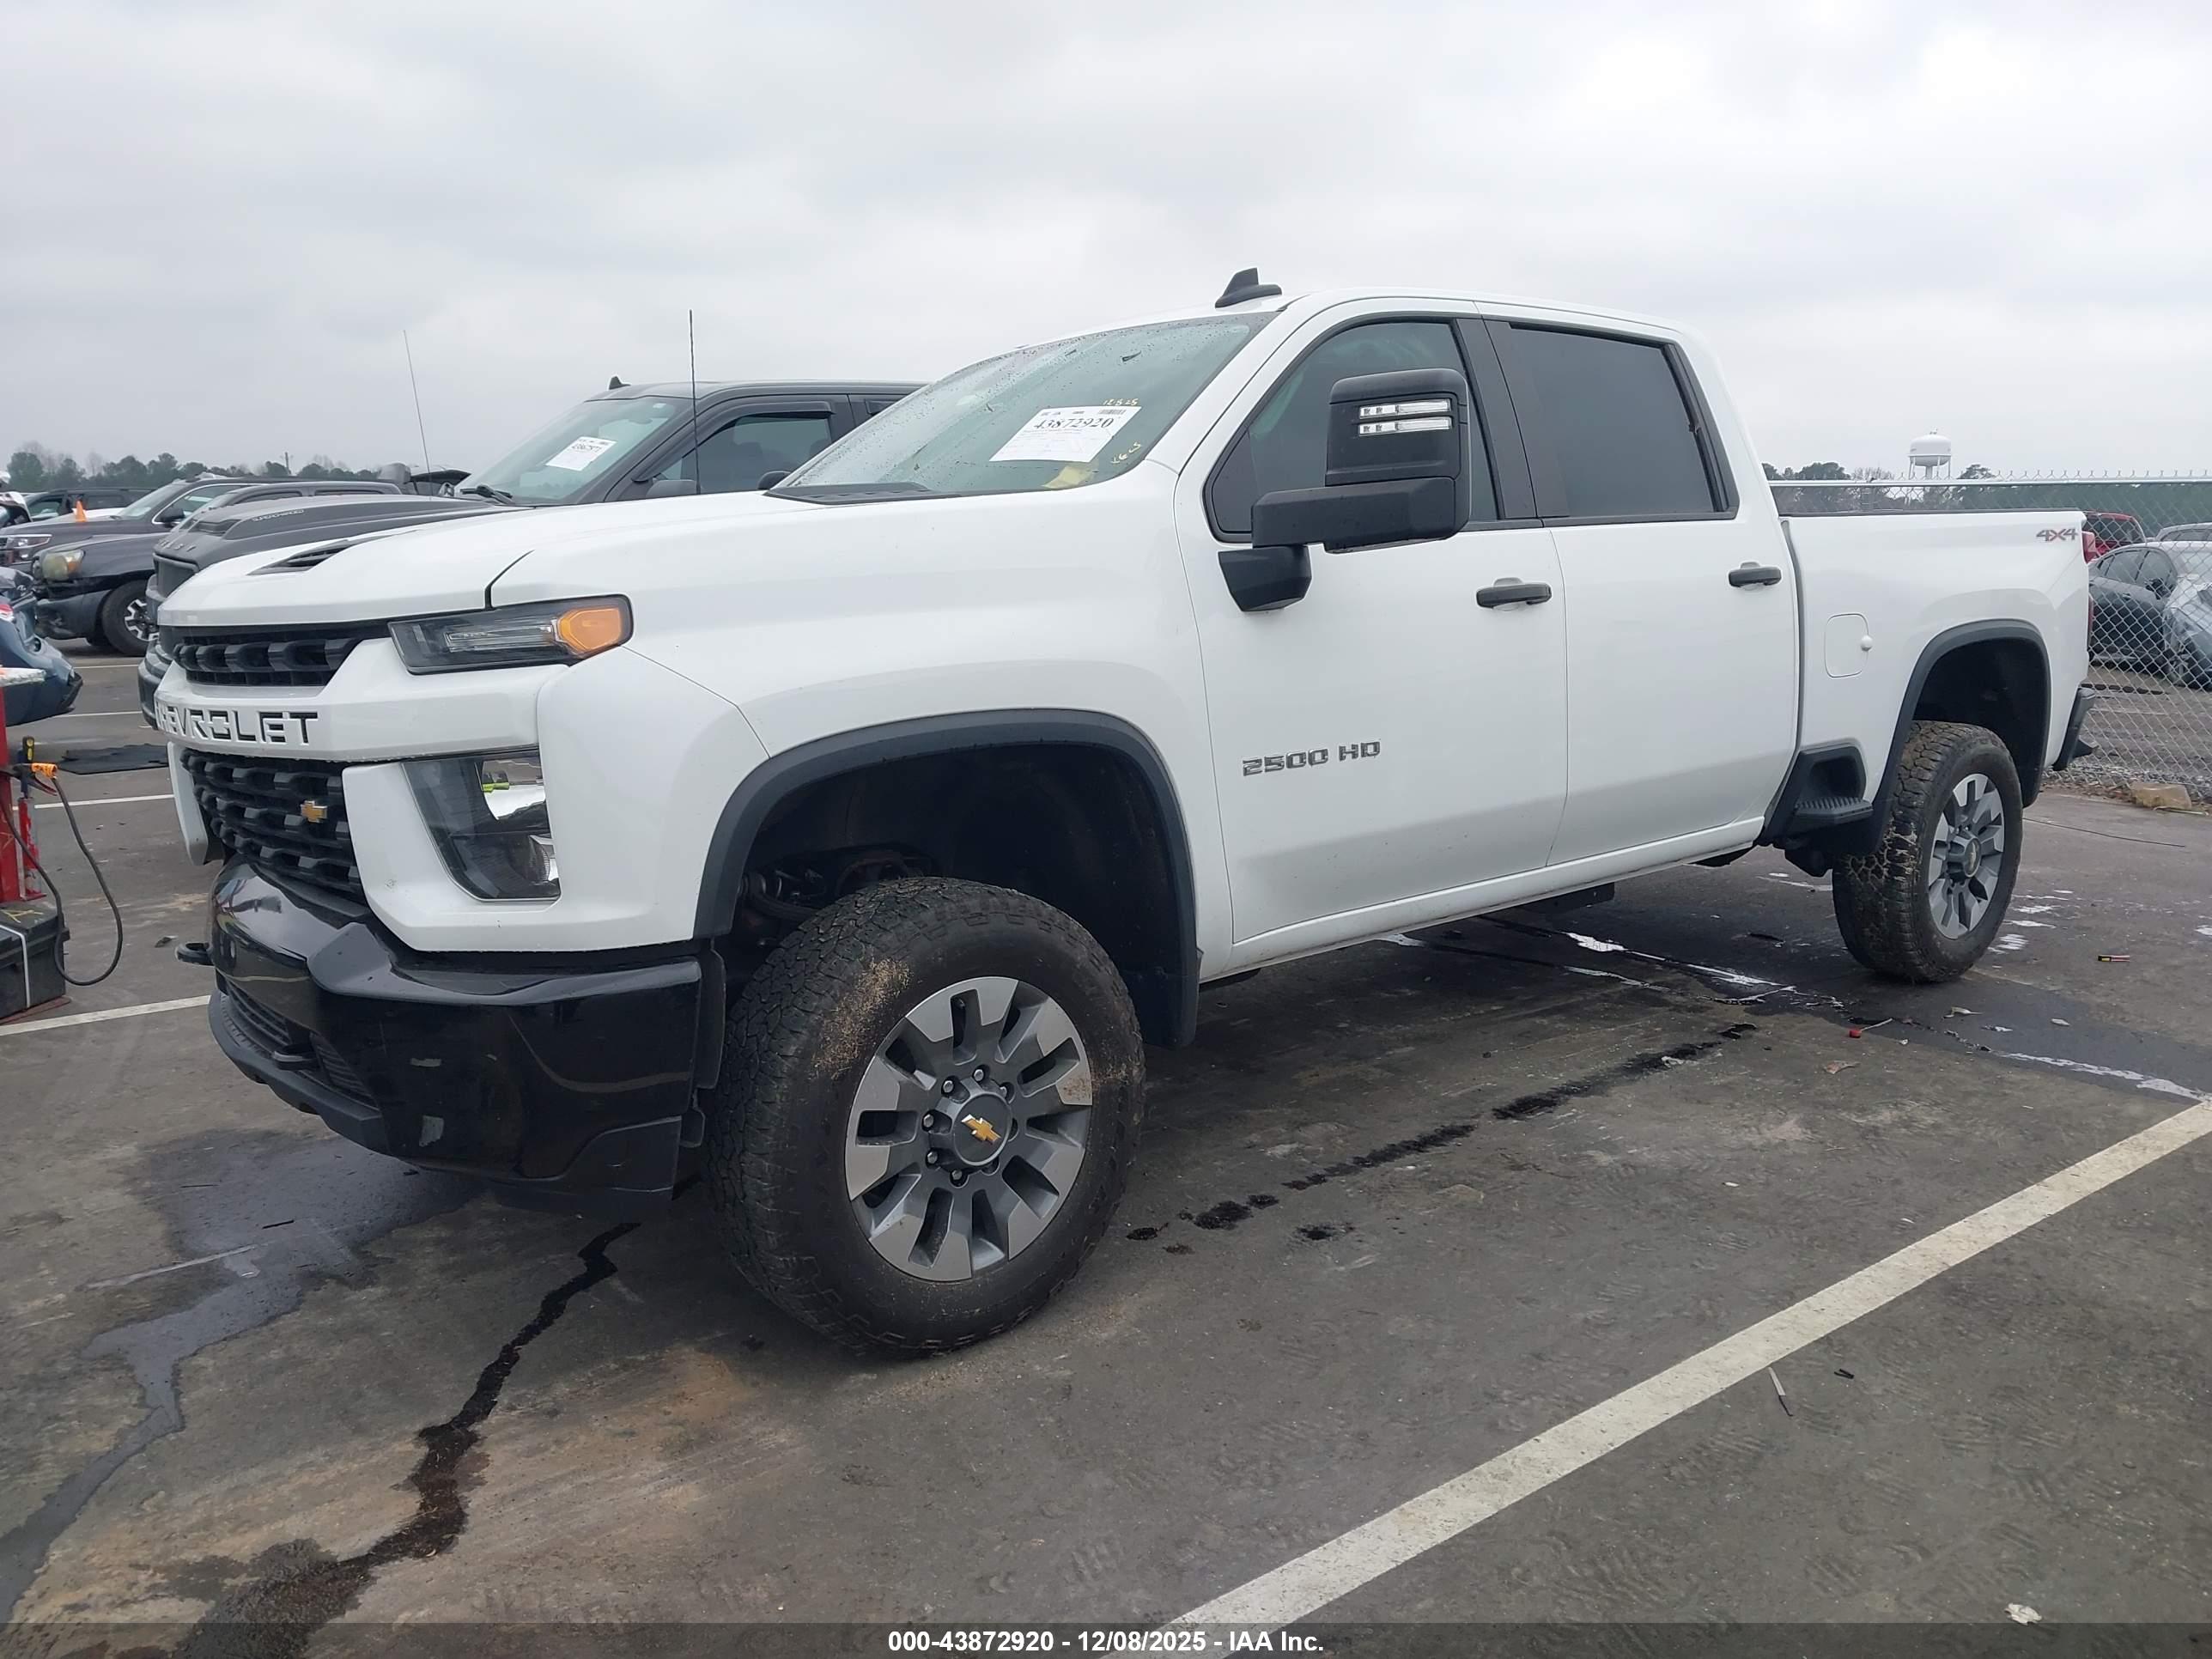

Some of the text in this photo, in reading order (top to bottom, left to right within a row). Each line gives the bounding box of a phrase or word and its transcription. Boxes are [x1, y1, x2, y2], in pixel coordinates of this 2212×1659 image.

[1034, 417, 1115, 428] 43872920
[1243, 741, 1381, 777] 2500 HD
